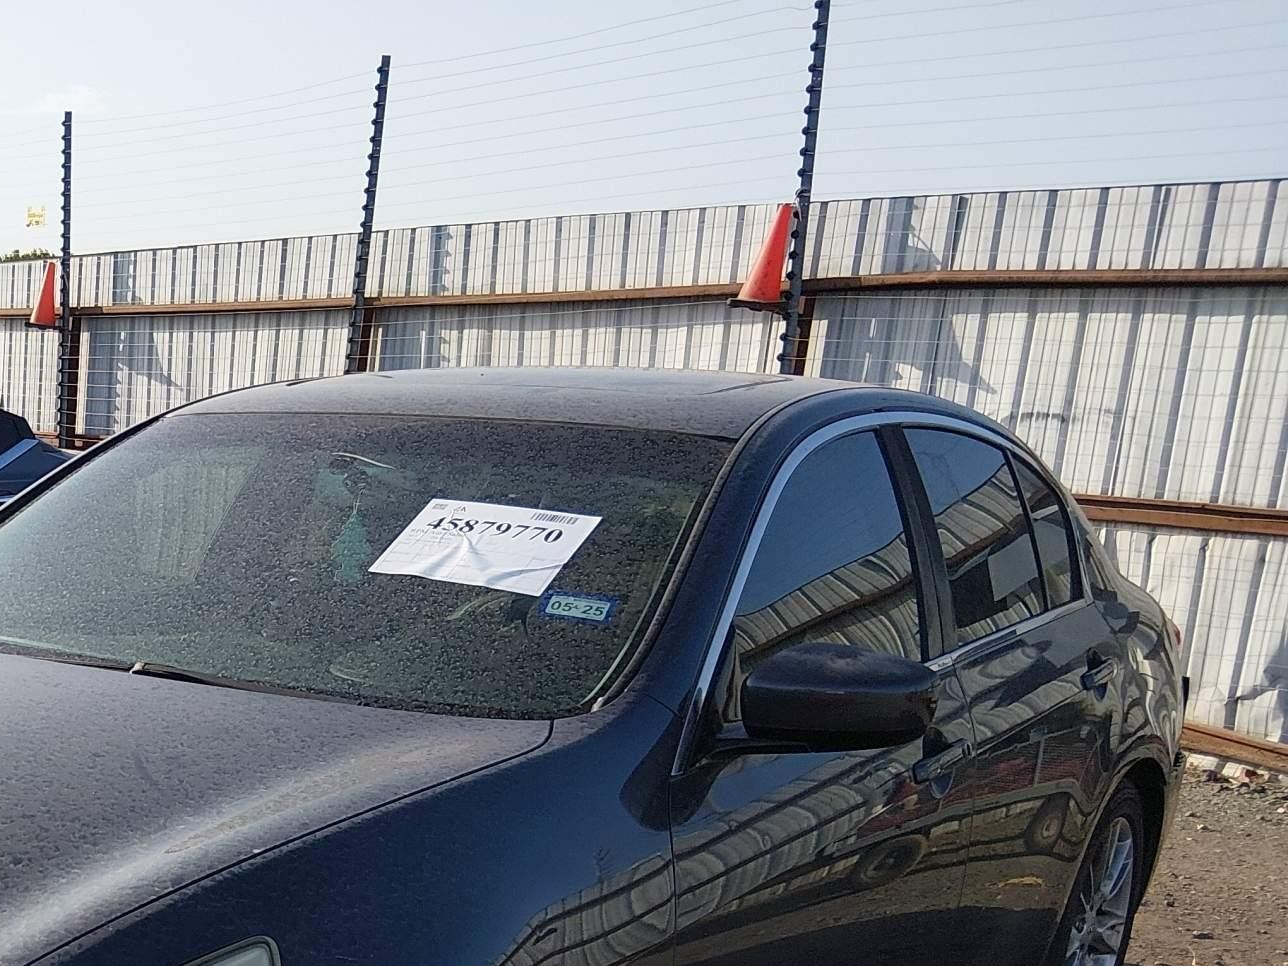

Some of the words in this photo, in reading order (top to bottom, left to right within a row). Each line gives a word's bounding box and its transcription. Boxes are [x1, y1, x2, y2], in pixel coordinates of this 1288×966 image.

[426, 516, 564, 544] 45879770
[550, 600, 574, 612] 05
[581, 604, 605, 616] 25
